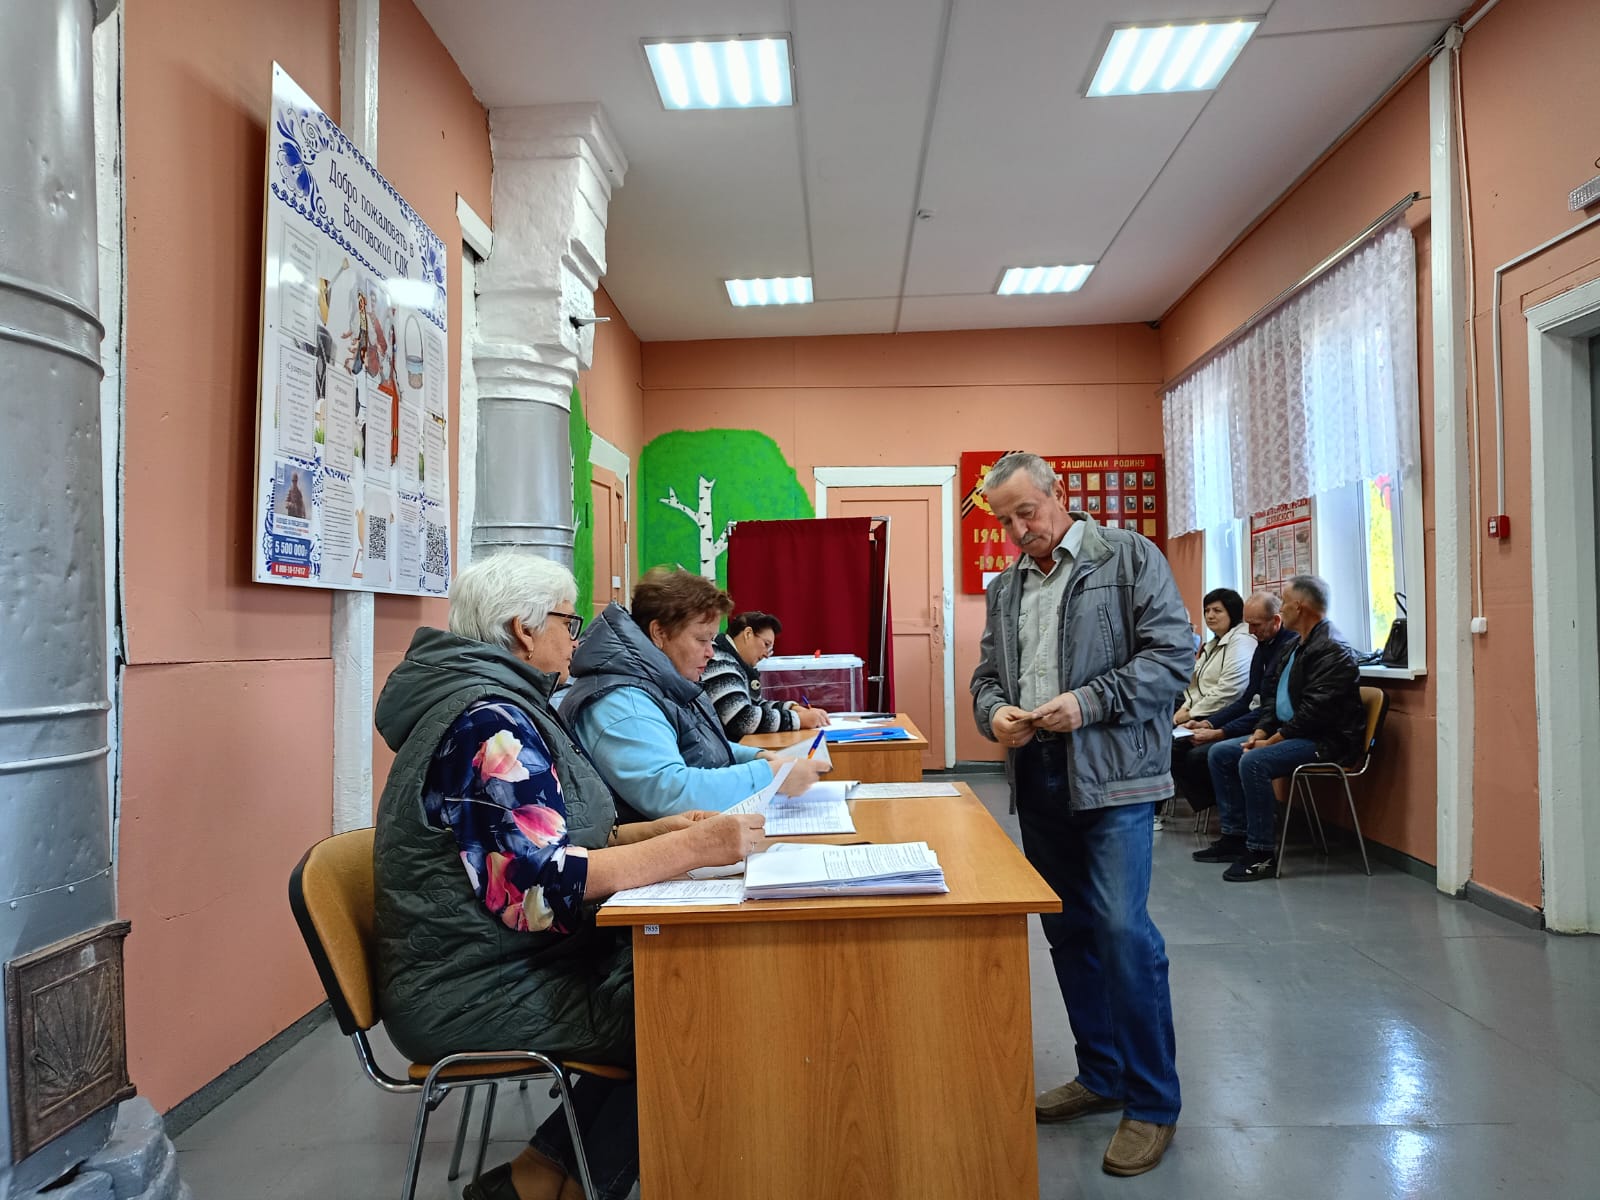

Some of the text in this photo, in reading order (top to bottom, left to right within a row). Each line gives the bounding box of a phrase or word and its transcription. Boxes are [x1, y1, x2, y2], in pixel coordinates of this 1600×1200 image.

[329, 158, 414, 258] Добро пожаловать в
[343, 202, 409, 279] Валтовский СДК
[1113, 459, 1145, 468] РОДИНУ
[973, 528, 1006, 543] 1941
[274, 540, 280, 553] 5
[280, 541, 293, 555] 500
